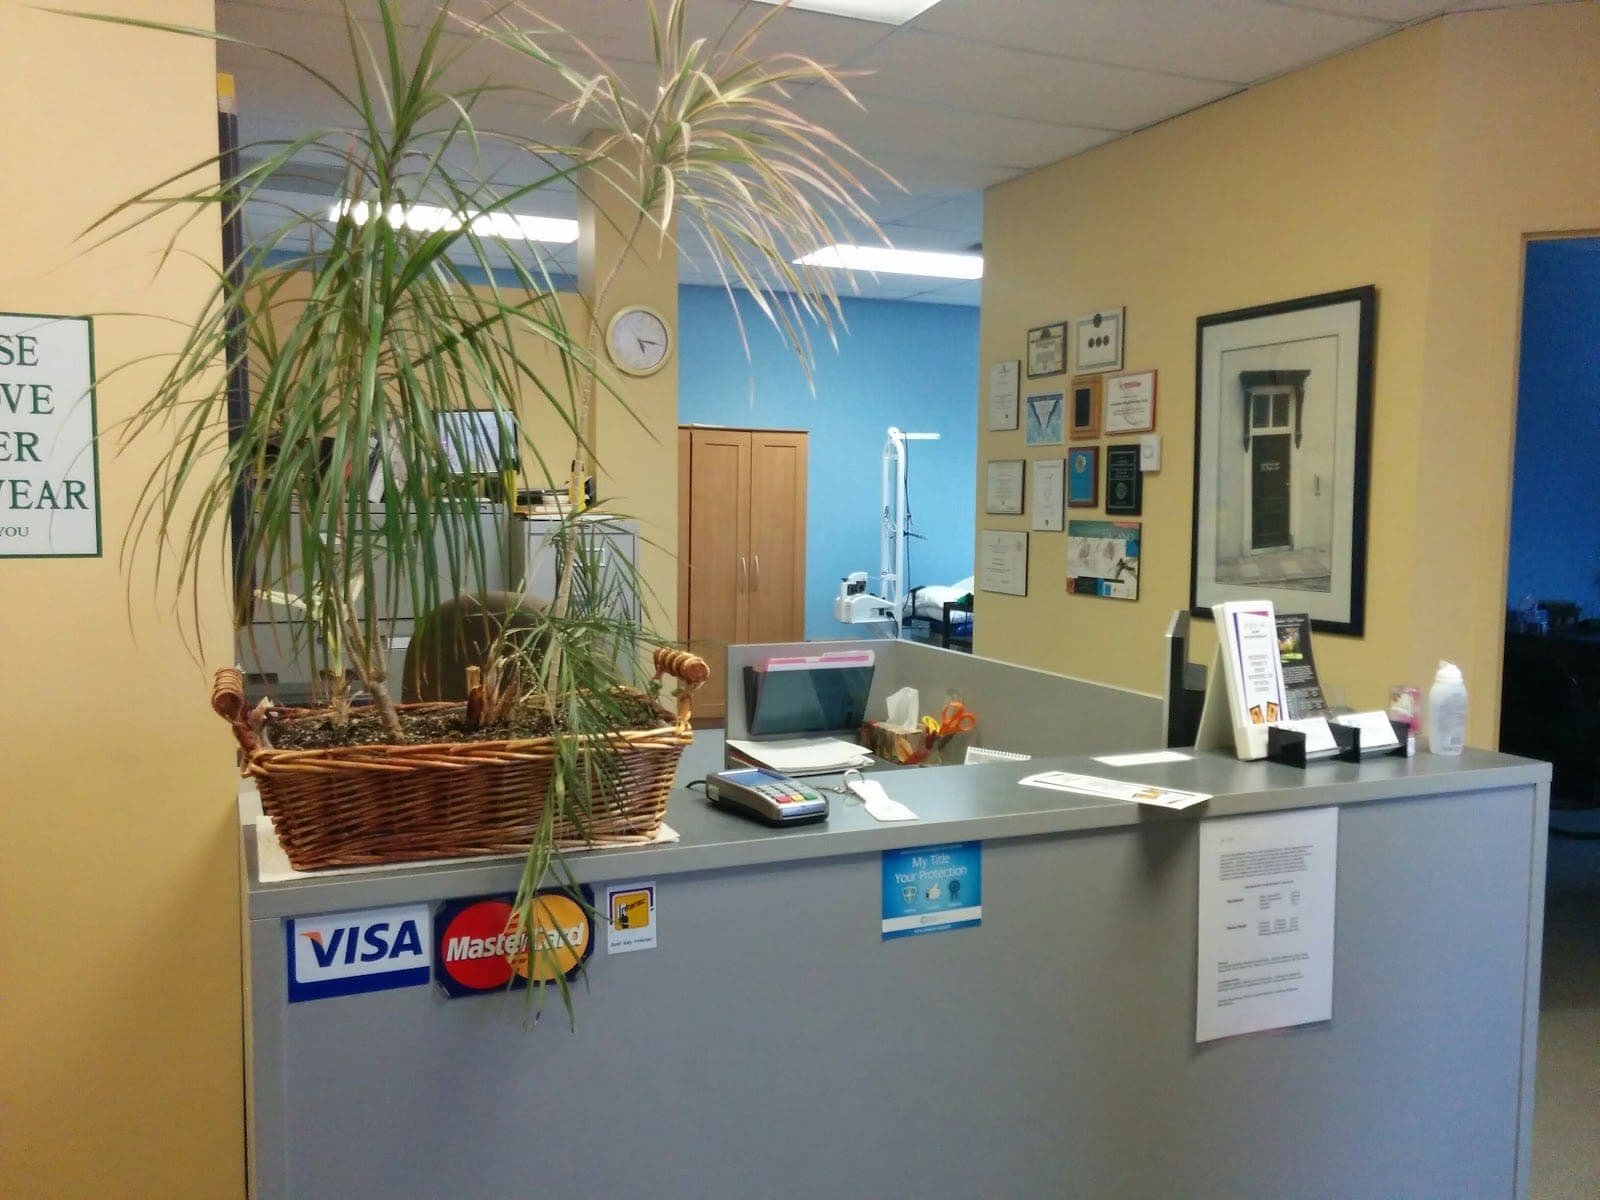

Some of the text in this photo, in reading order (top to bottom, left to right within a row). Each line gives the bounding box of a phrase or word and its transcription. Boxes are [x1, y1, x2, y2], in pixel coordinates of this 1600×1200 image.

[0, 334, 39, 367] SE
[0, 383, 55, 415] VE
[0, 479, 89, 510] EAR
[895, 866, 967, 884] Your Protection
[912, 856, 928, 869] My
[300, 919, 423, 968] VISA
